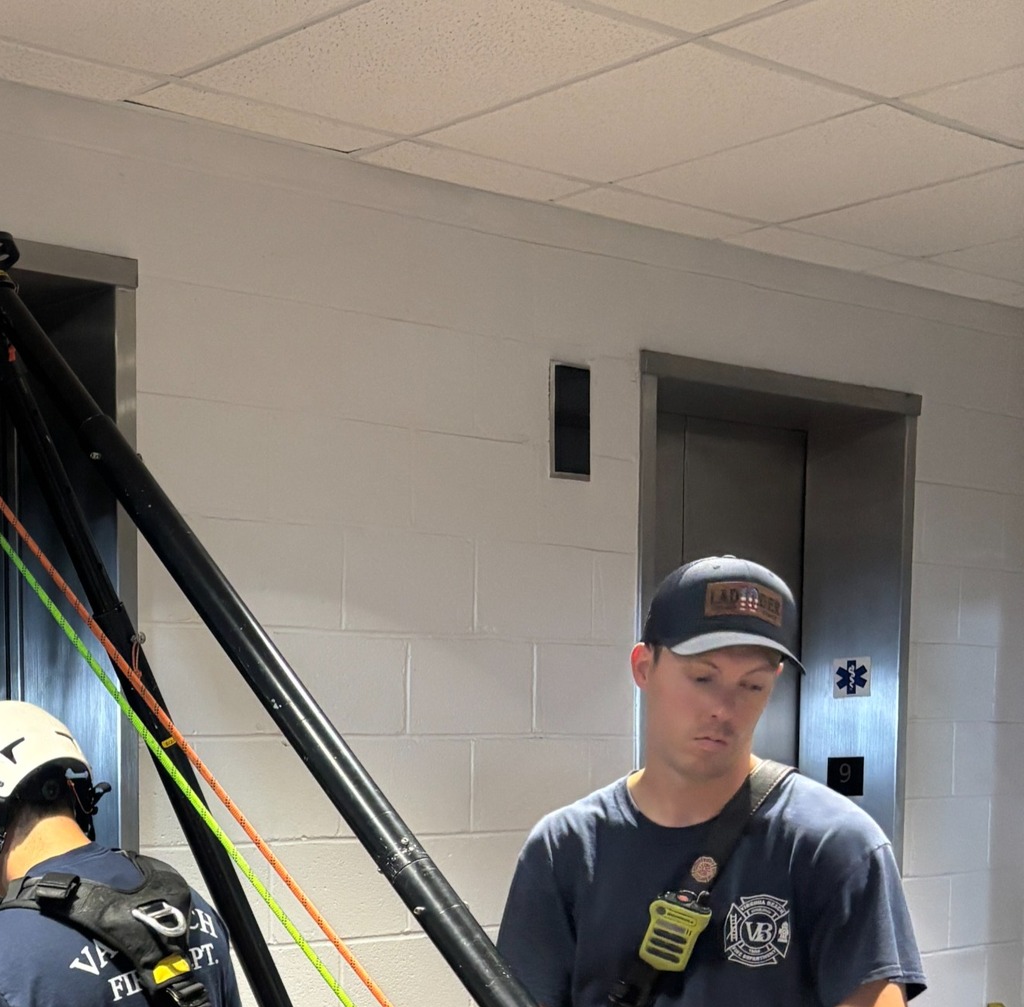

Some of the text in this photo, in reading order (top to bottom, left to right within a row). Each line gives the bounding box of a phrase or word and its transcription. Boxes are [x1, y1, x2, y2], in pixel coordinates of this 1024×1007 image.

[839, 763, 851, 783] 9
[745, 921, 773, 942] VB
[188, 943, 219, 971] PT.
